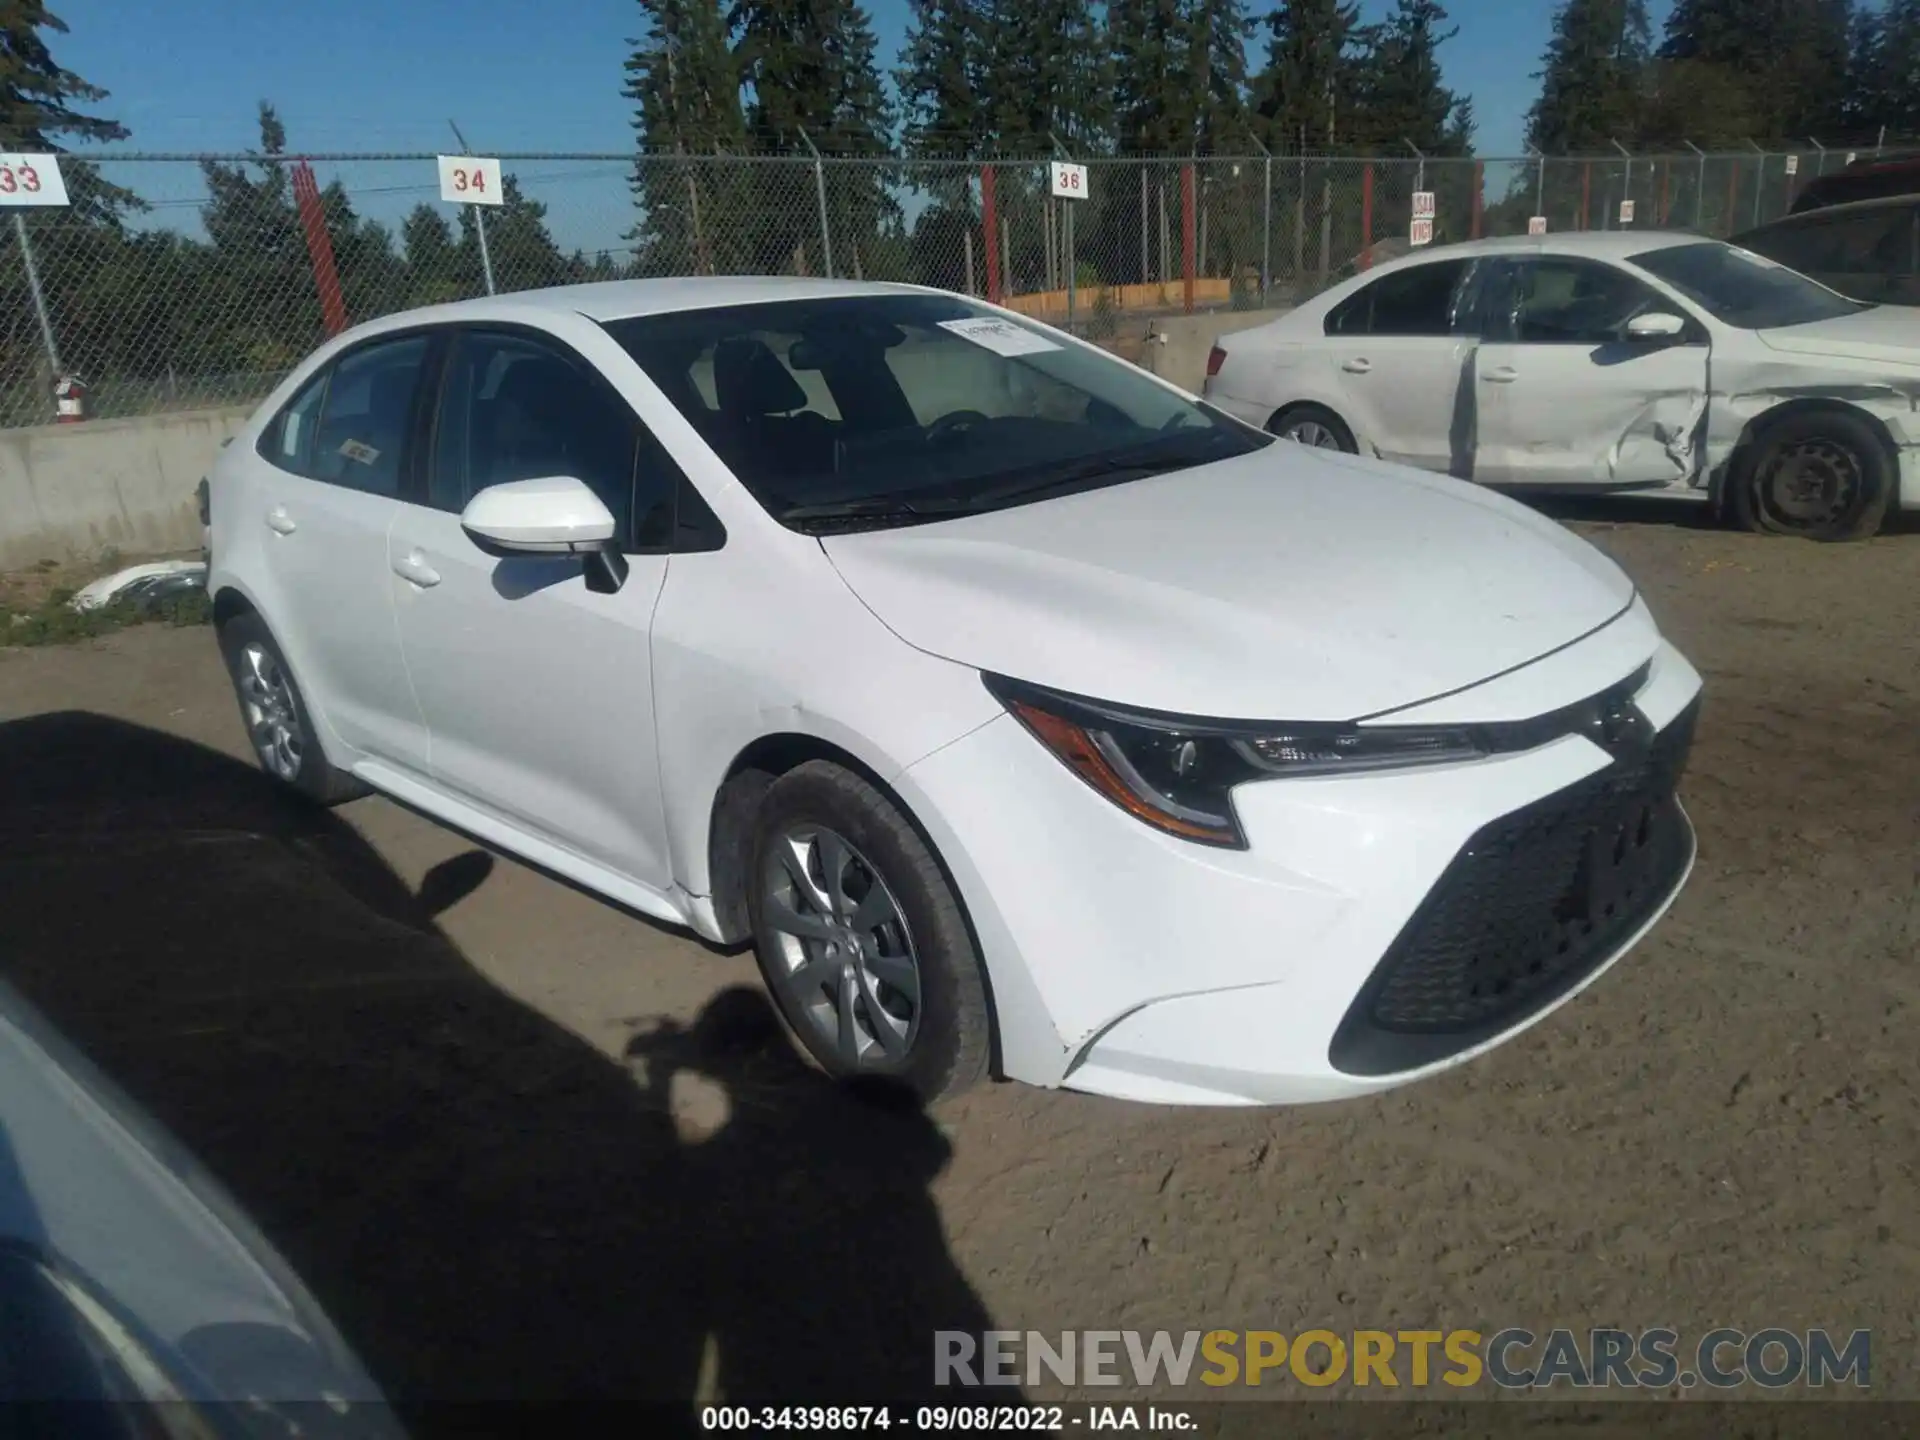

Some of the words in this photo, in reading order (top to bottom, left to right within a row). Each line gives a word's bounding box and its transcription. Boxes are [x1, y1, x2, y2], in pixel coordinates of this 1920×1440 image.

[0, 166, 41, 193] 33
[453, 169, 485, 193] 34
[1059, 171, 1080, 190] 36
